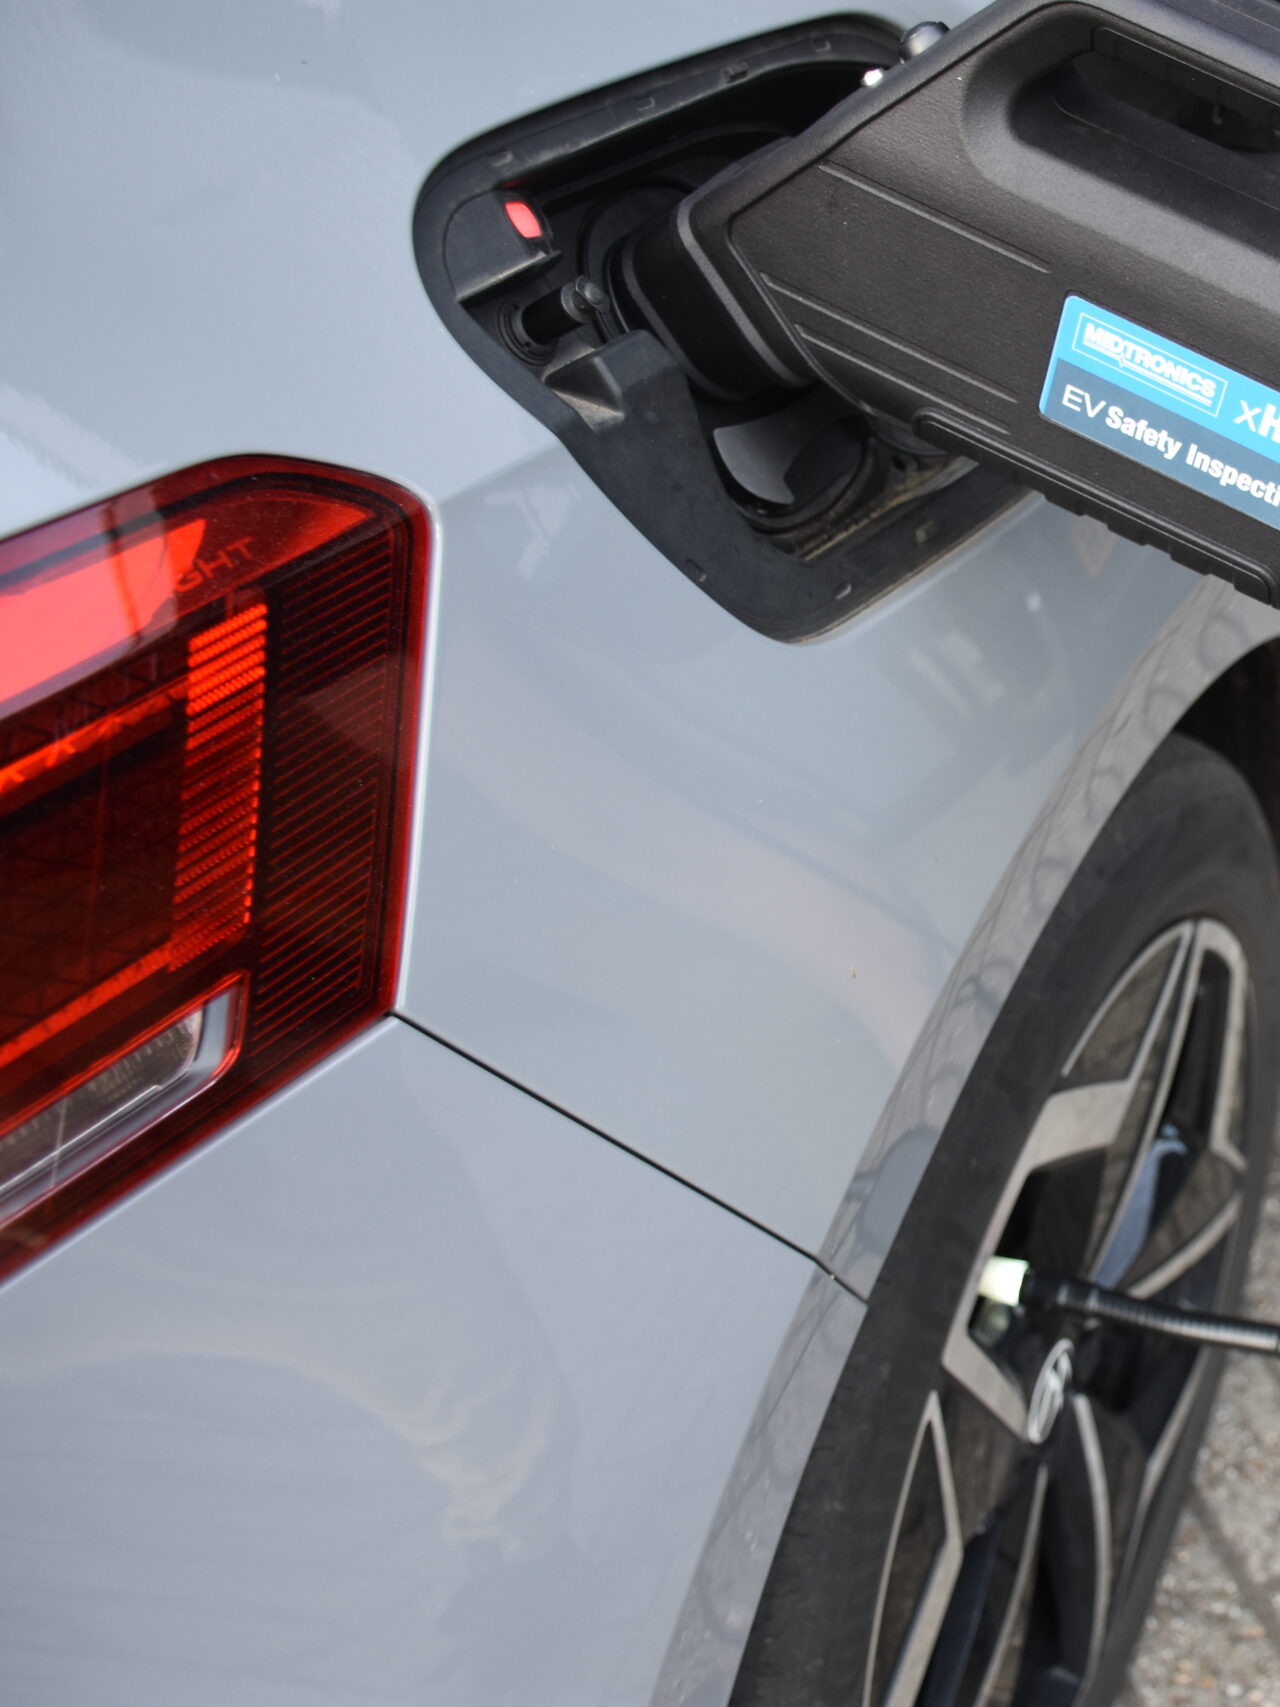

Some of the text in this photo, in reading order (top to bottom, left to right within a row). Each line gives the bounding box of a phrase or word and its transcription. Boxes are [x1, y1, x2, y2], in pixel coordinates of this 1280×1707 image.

[1083, 323, 1217, 397] MIDTRONICS
[1061, 384, 1106, 419] EV
[1105, 405, 1182, 460] Safety
